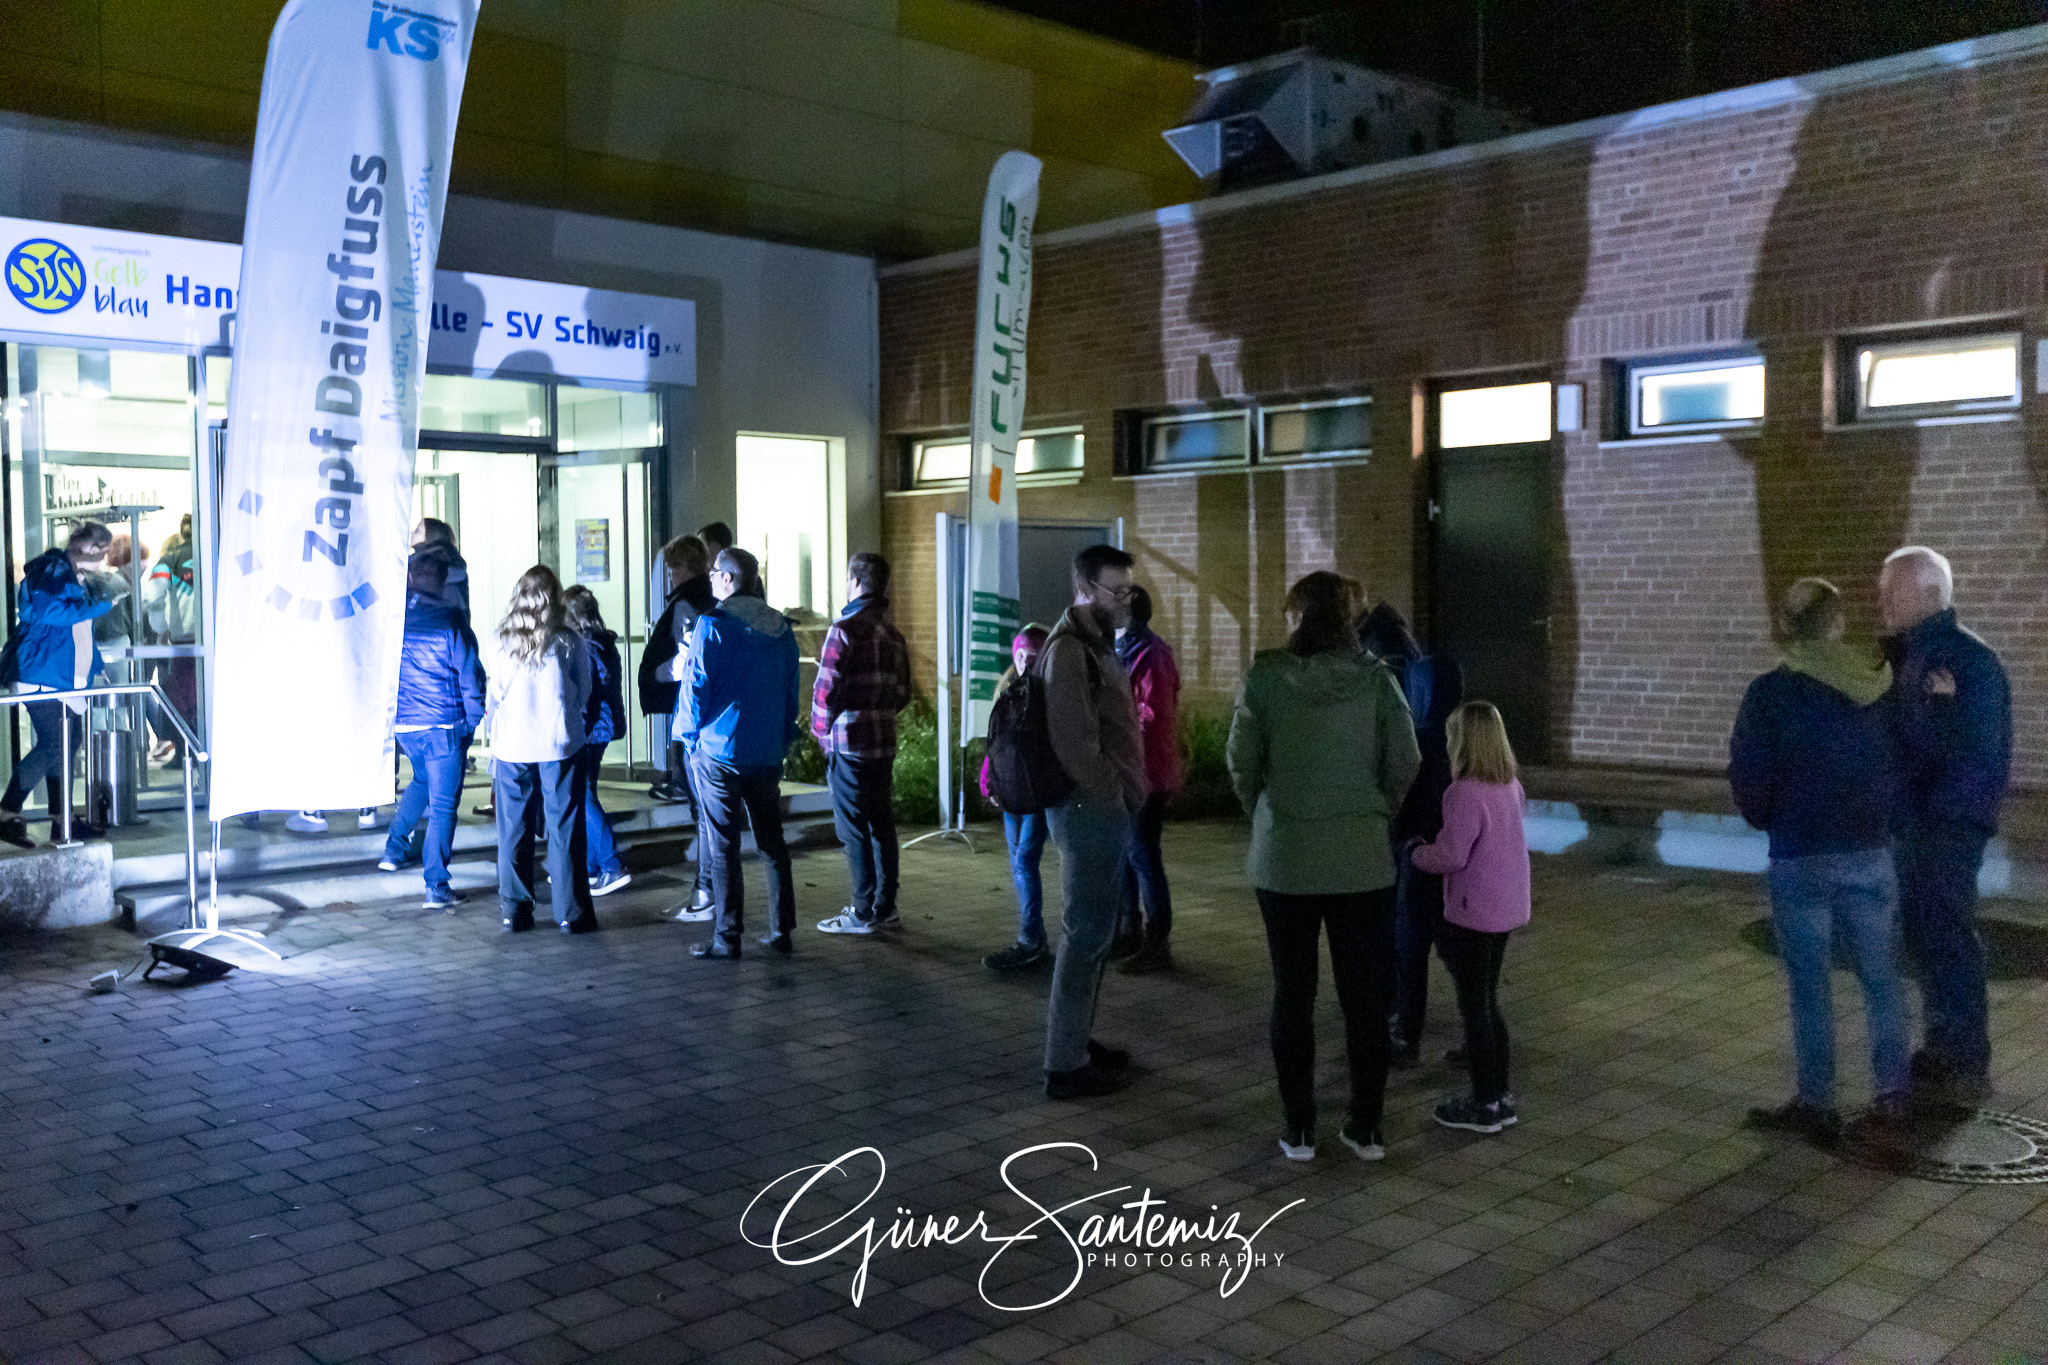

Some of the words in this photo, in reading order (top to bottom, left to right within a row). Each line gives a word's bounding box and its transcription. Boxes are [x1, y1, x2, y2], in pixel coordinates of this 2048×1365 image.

[367, 10, 440, 61] KS
[94, 257, 148, 287] Gelb
[94, 285, 148, 318] blau
[315, 153, 388, 418] Daigfuss
[166, 274, 239, 310] Han
[506, 311, 543, 339] SV
[555, 316, 660, 357] Schwaig
[302, 426, 364, 567] Zapf
